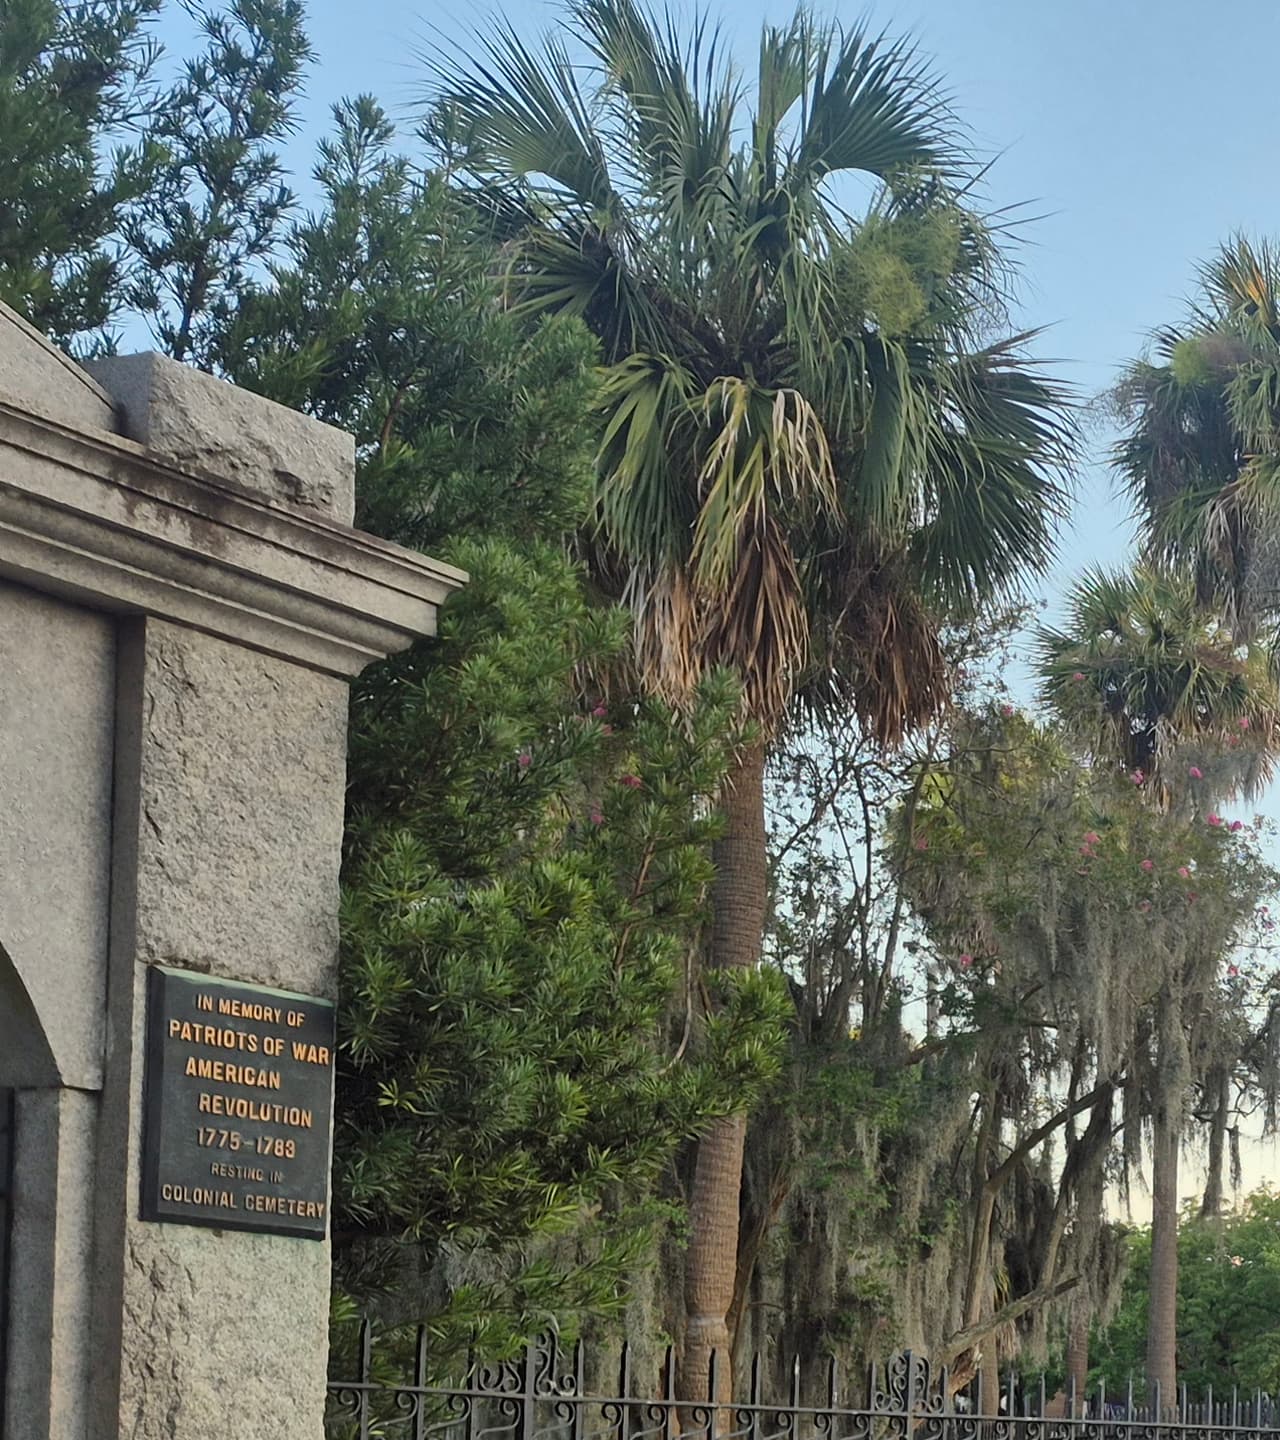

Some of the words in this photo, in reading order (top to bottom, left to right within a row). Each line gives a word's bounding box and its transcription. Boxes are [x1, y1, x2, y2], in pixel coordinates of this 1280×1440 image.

[197, 993, 213, 1012] IN
[218, 998, 282, 1023] MEMORY
[287, 1010, 306, 1028] OF
[168, 1019, 258, 1052] PATRIOTS
[263, 1035, 285, 1057] OF
[292, 1041, 330, 1065] WAR
[185, 1056, 281, 1090] AMERICAN
[199, 1093, 312, 1128] REVOLUTION
[198, 1127, 296, 1159] 1775-1783
[211, 1162, 264, 1181] RESTING
[269, 1171, 284, 1185] IN
[162, 1183, 238, 1210] COLONIAL
[245, 1193, 325, 1219] CEMETERY
